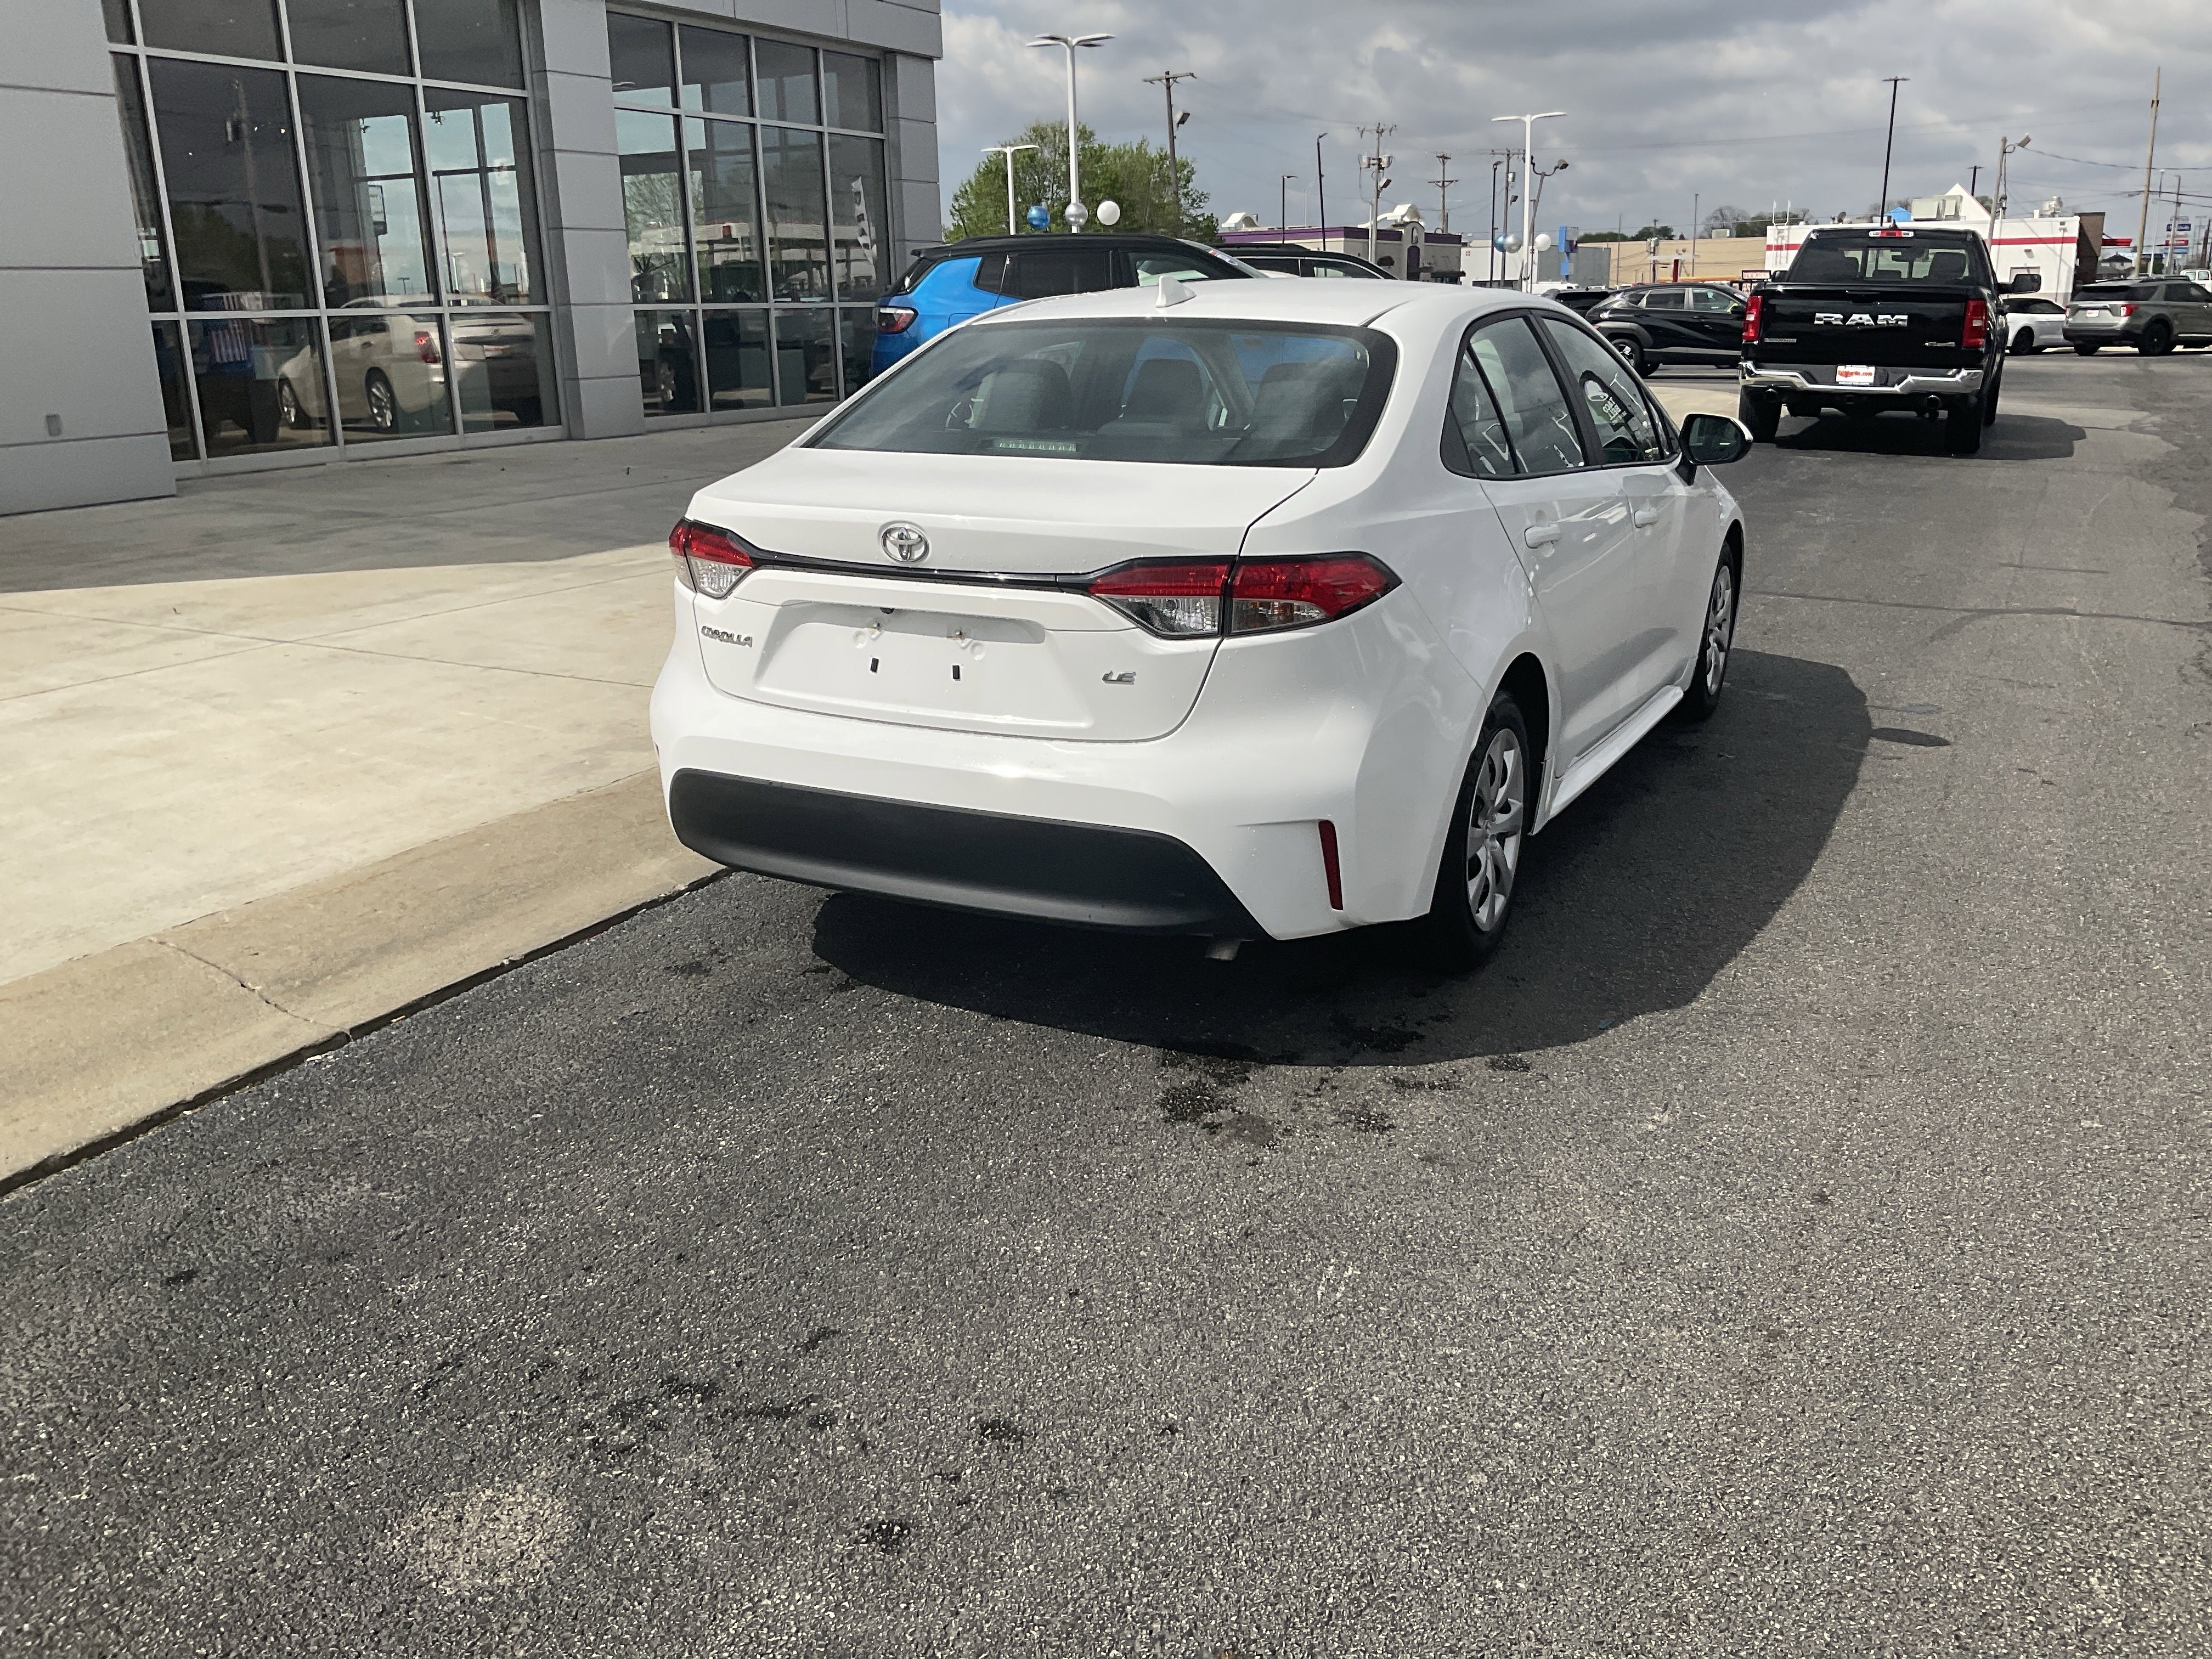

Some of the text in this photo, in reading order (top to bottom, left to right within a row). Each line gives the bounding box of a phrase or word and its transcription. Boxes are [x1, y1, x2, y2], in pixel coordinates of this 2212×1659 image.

[1814, 313, 1908, 326] RAM
[701, 625, 752, 647] COROLLA
[1102, 671, 1136, 685] LE
